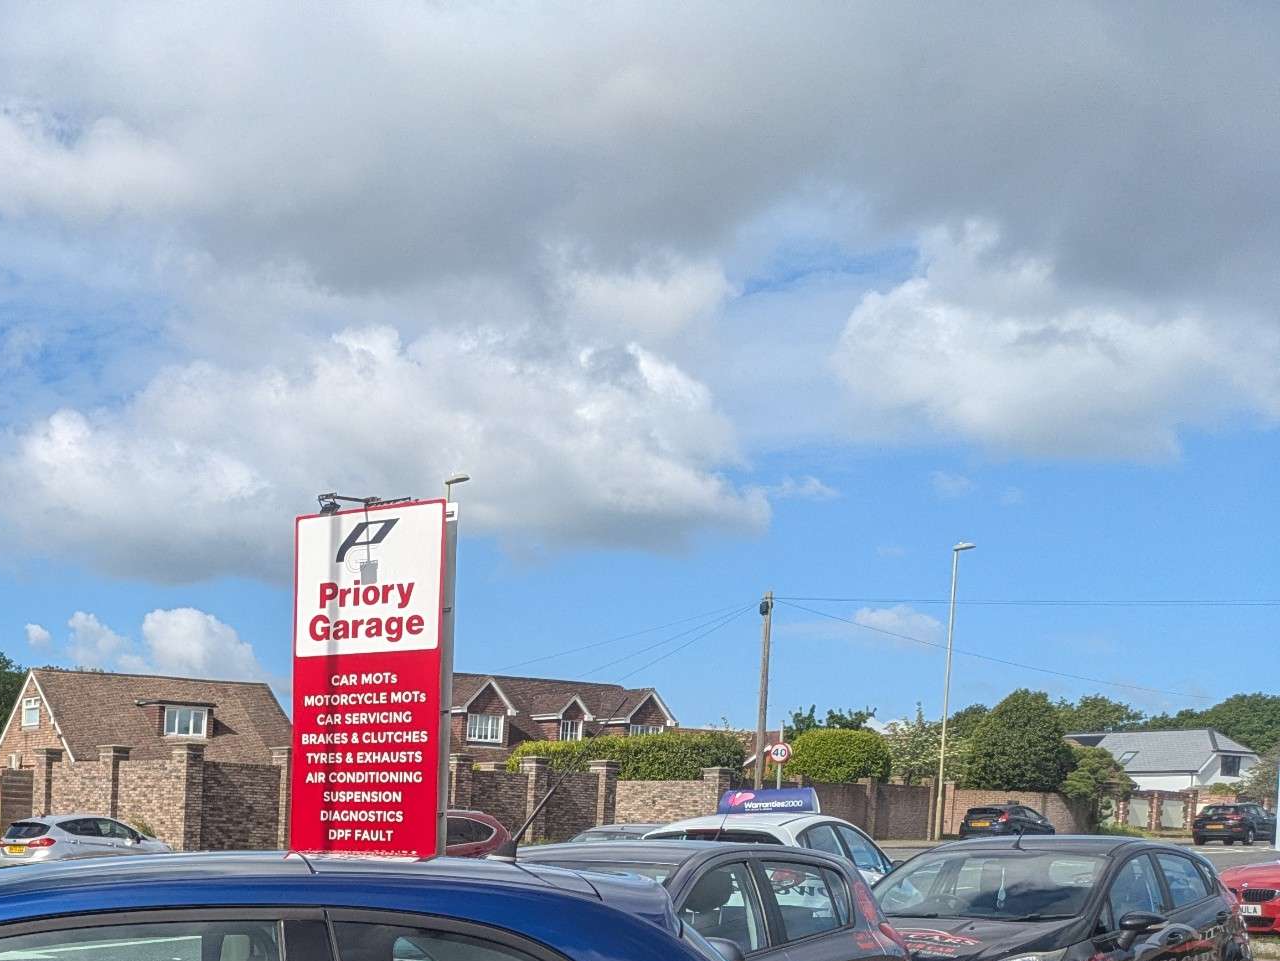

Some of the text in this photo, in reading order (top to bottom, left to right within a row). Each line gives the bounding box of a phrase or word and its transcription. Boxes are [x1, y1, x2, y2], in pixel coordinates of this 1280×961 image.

[319, 580, 415, 609] Priory
[309, 614, 425, 642] Garage
[331, 672, 398, 686] CAR MOTs
[304, 690, 427, 707] MOTORCYCLE MOTs
[316, 711, 412, 725] CAR SERVICING
[301, 730, 429, 745] BRAKES & CLUTCHES
[306, 750, 423, 765] TYRES & EXHAUSTS
[772, 748, 787, 757] 40
[305, 771, 423, 784] AIR CONDITIONING
[323, 790, 402, 803] SUSPENSION
[320, 810, 404, 823] DIAGNOSTICS
[328, 829, 394, 842] DPF FAULT
